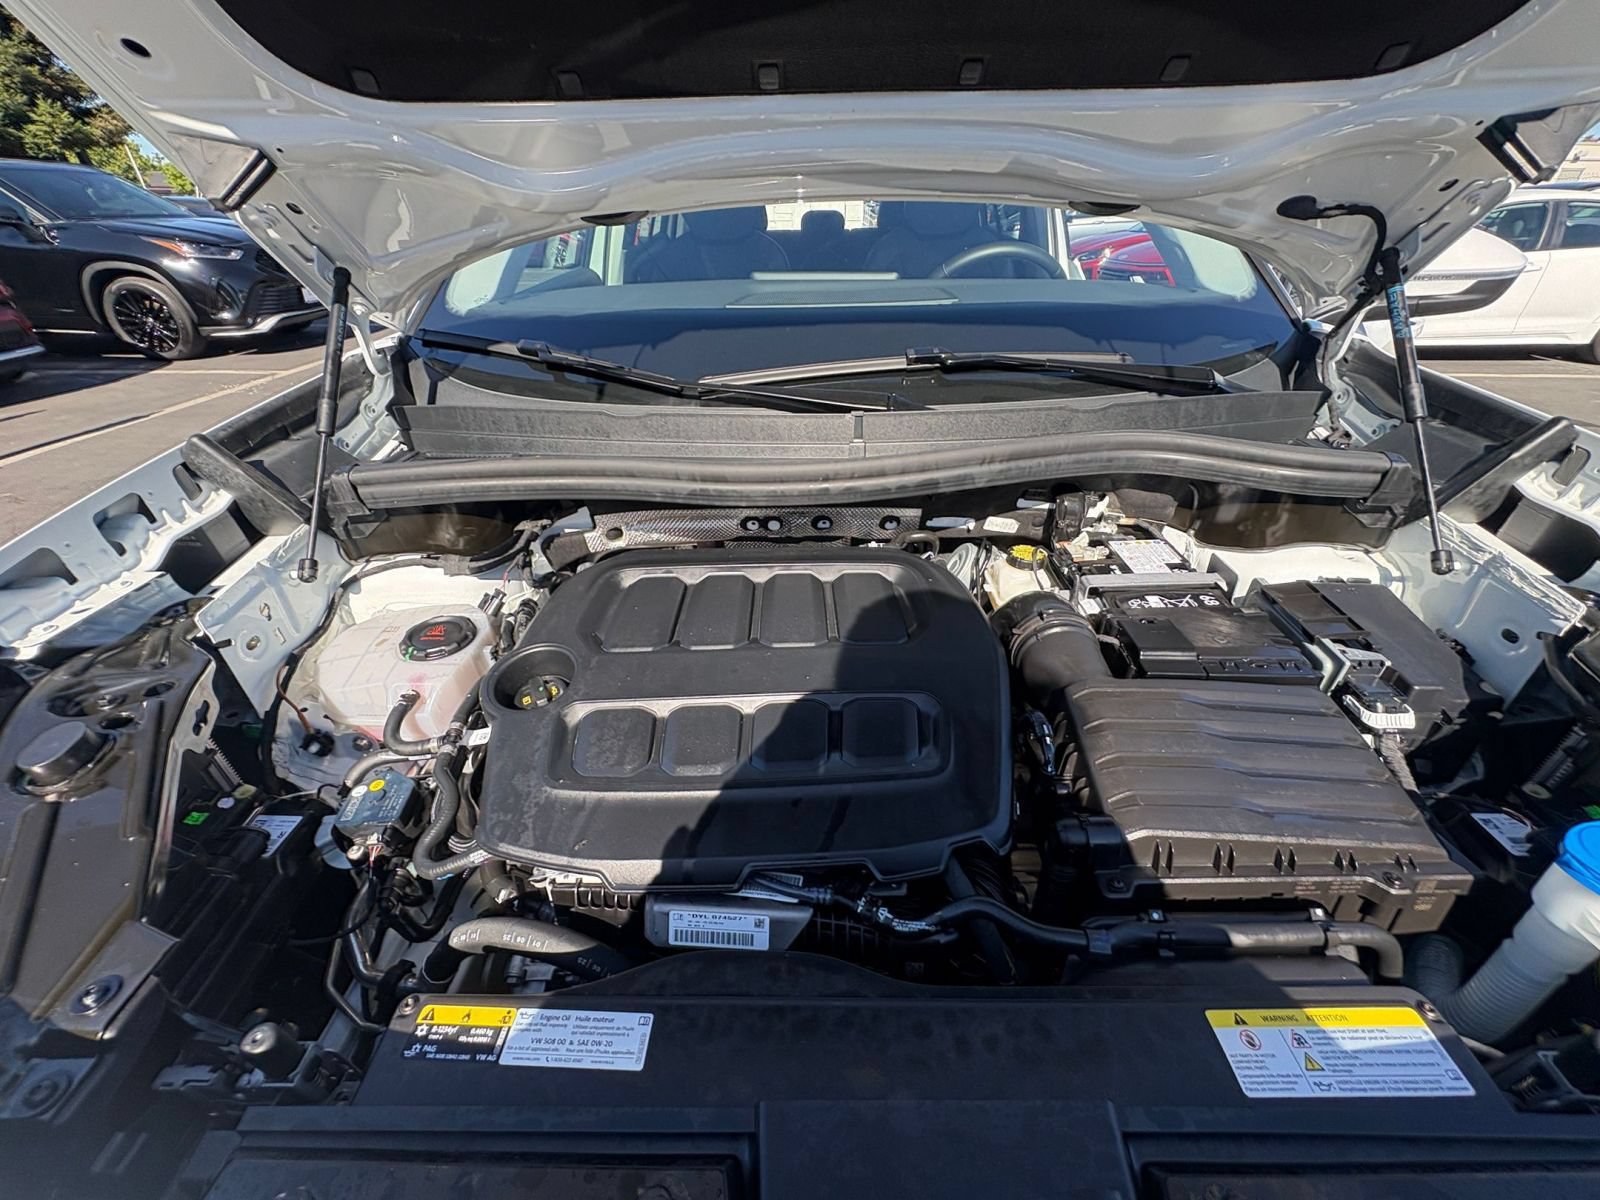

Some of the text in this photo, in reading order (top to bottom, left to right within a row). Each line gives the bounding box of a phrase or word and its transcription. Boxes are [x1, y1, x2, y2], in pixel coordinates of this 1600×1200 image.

[540, 1014, 560, 1022] Engine
[1306, 1014, 1349, 1022] ATTENTION
[557, 1038, 567, 1046] 00
[577, 1039, 590, 1047] SAE
